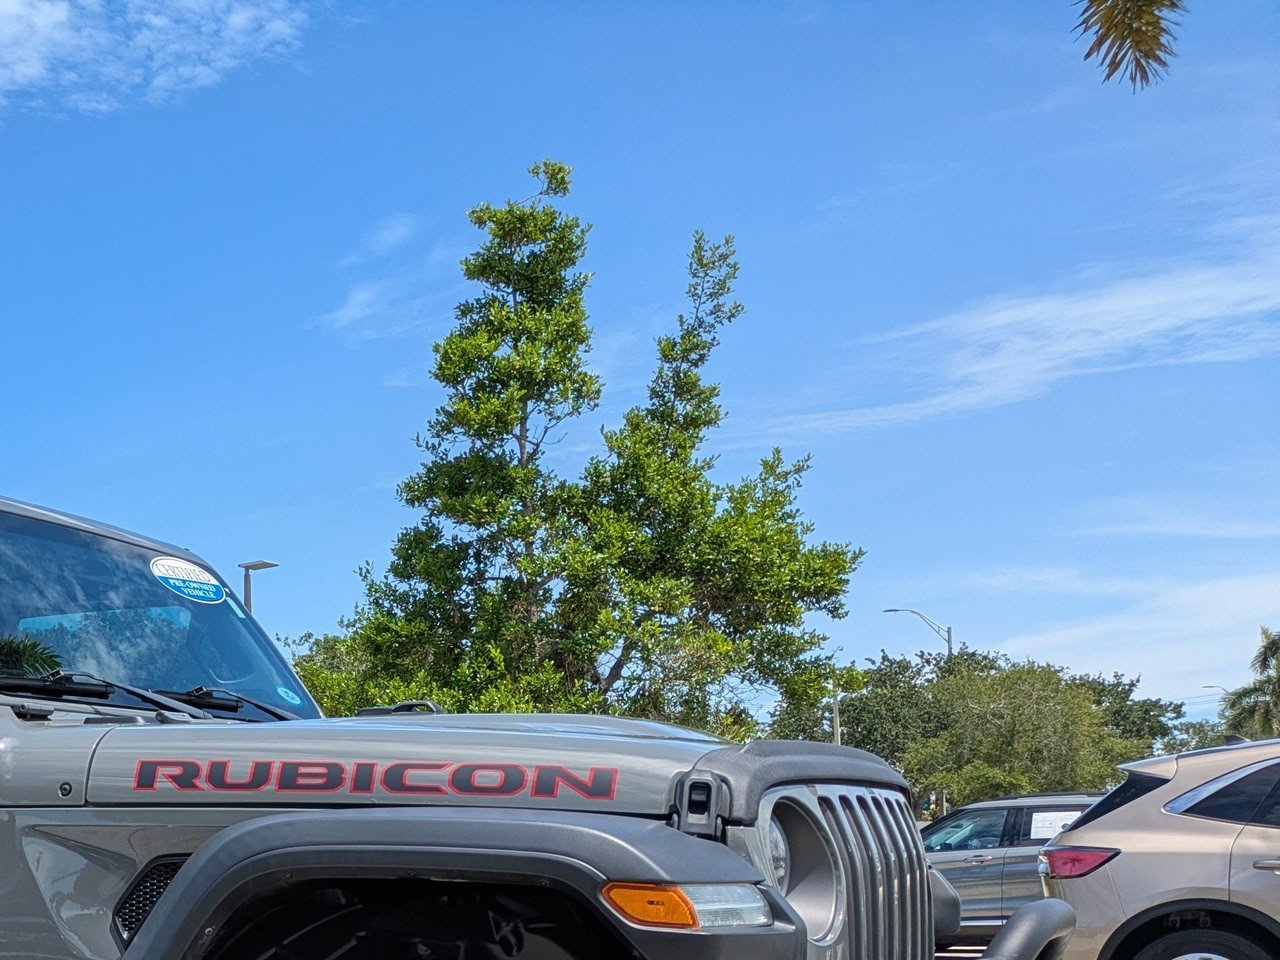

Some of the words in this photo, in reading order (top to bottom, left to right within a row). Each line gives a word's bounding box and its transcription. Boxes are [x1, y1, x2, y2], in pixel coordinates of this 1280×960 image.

[155, 563, 211, 582] CERTIFIED
[180, 587, 217, 599] VEHICLE
[133, 760, 618, 800] RUBICON
